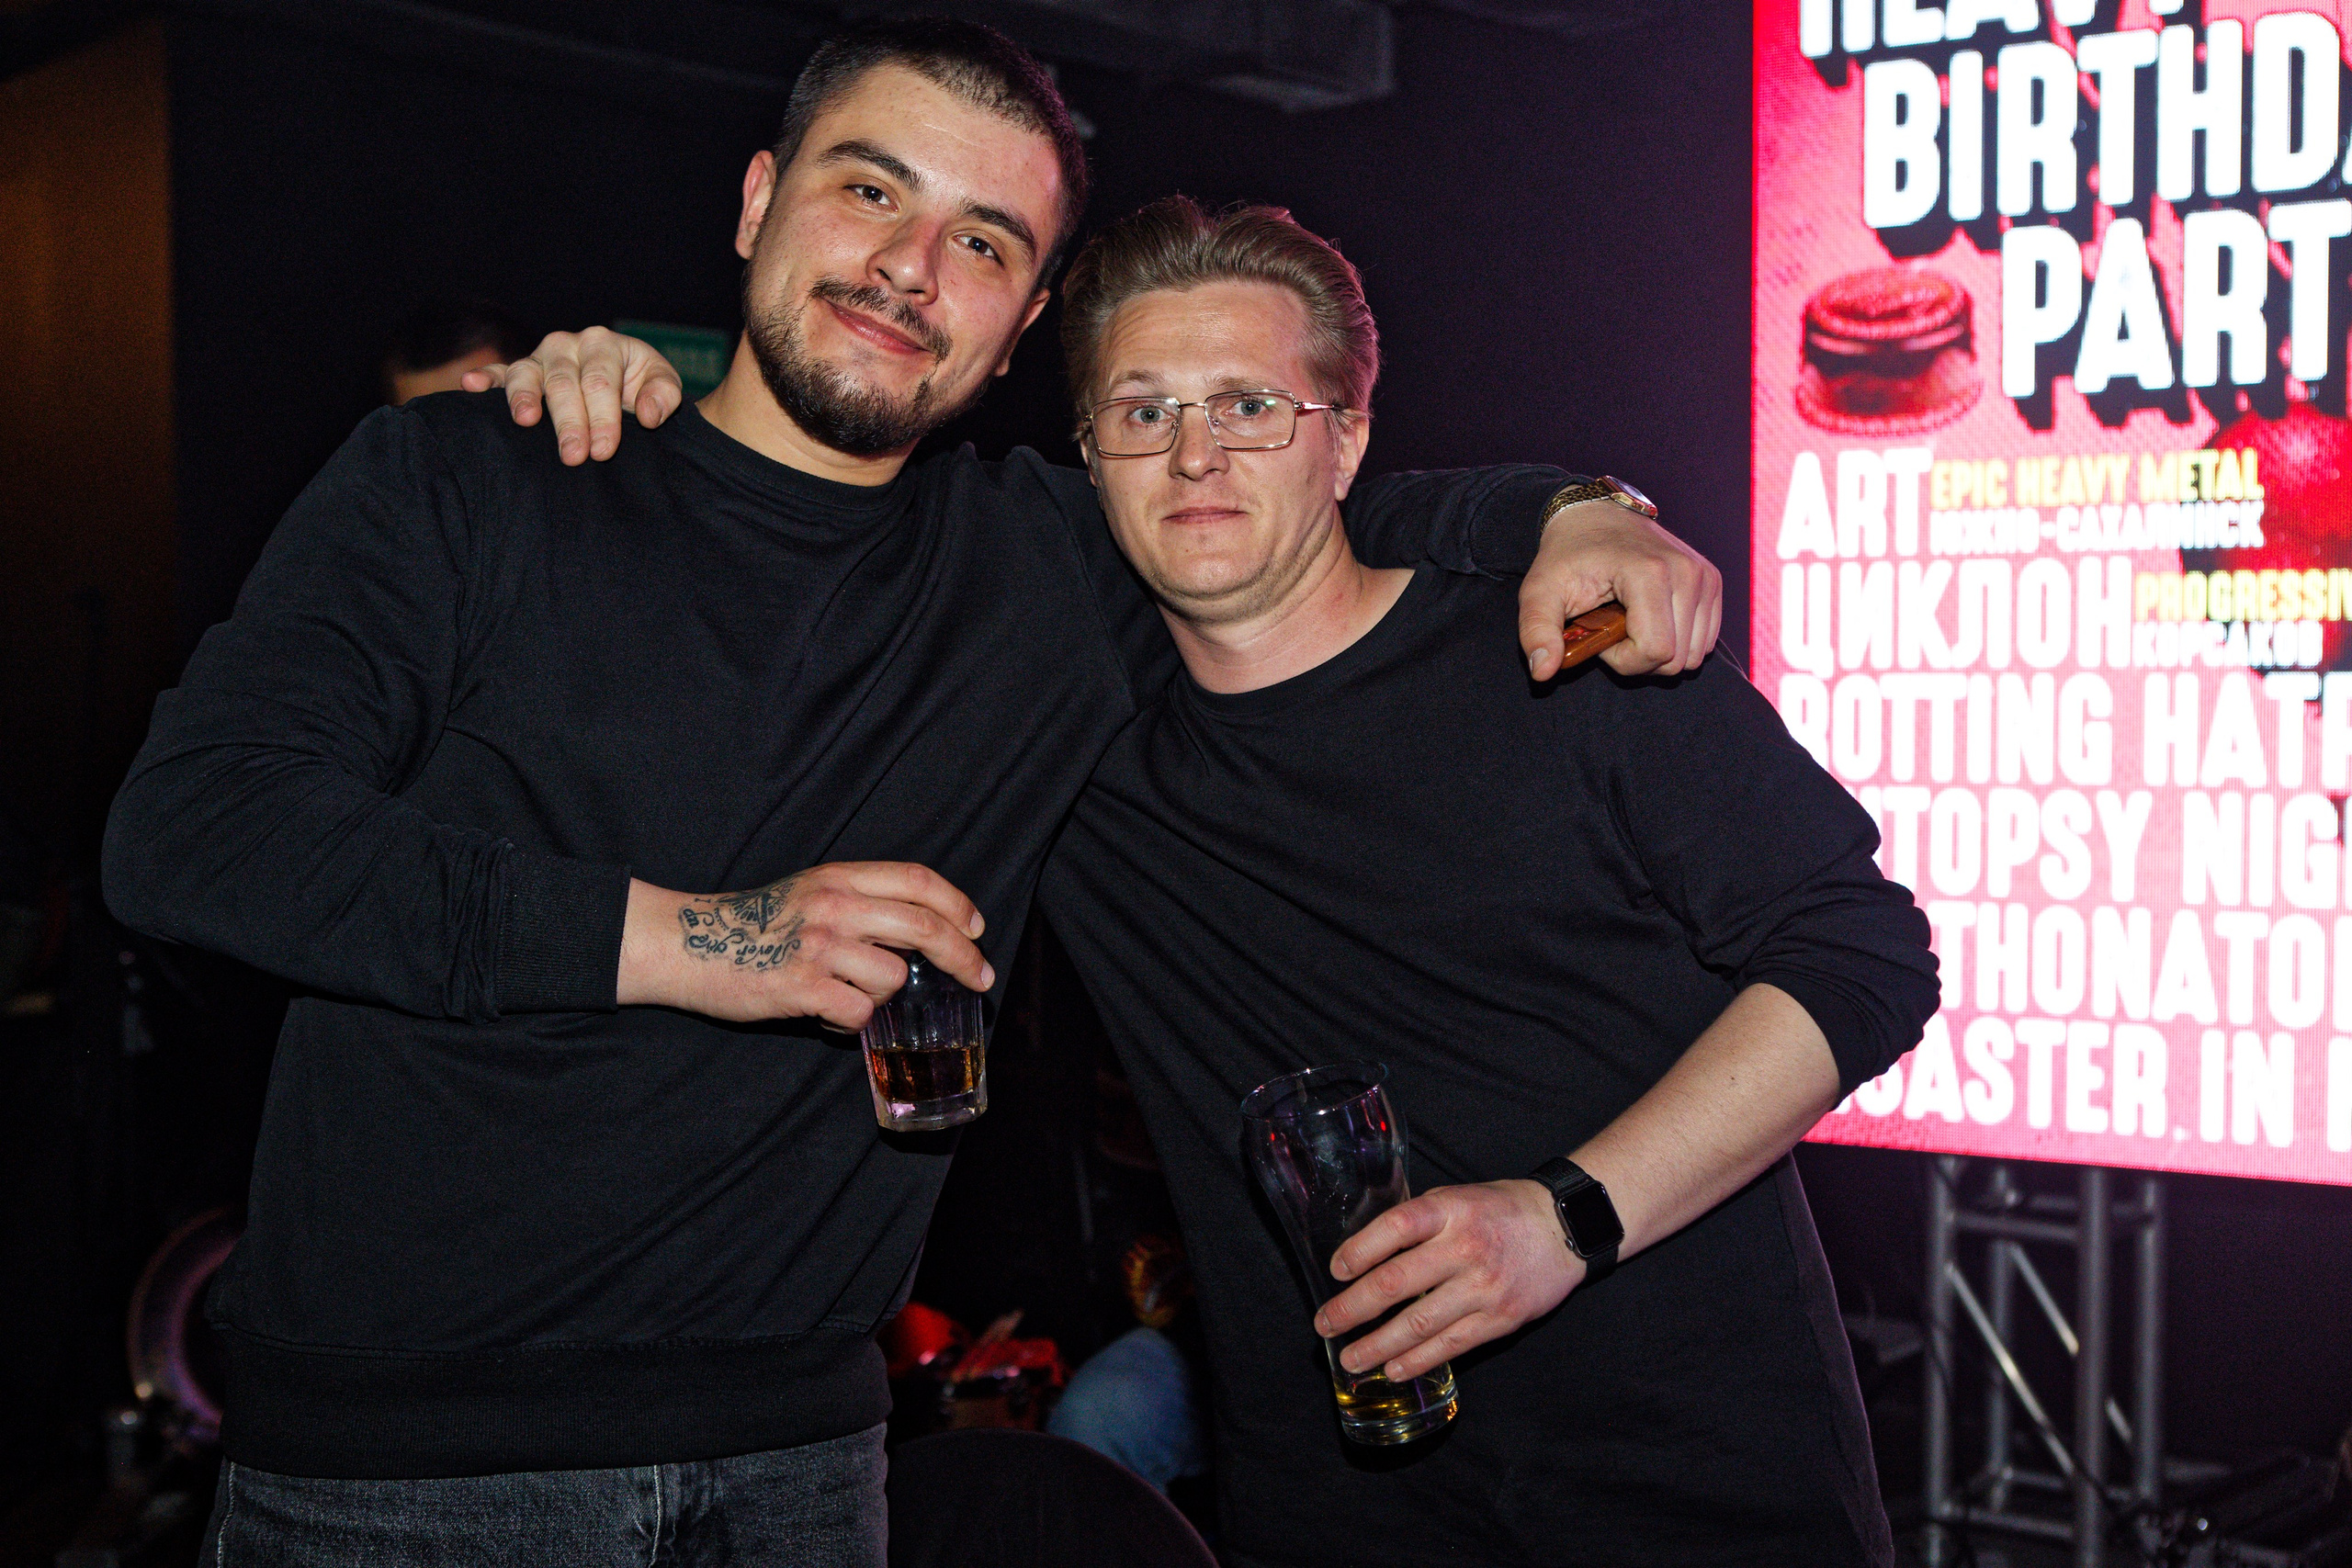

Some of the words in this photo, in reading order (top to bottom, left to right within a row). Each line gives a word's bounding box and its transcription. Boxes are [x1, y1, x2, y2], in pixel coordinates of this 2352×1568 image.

[1862, 9, 2352, 229] BIRTHD
[2001, 197, 2352, 399] PART
[1777, 447, 1932, 559] ART
[1930, 457, 2009, 511] EPIC
[2015, 451, 2132, 508] HEAVY
[2138, 446, 2266, 503] METAL
[1780, 556, 2132, 680] ЦИКЛОН
[1779, 671, 2114, 786] ROTTING
[1845, 785, 2154, 903] TOPSY
[2182, 790, 2352, 910] NIG
[1833, 1010, 2168, 1139] ASTER
[2199, 1028, 2296, 1149] IN
